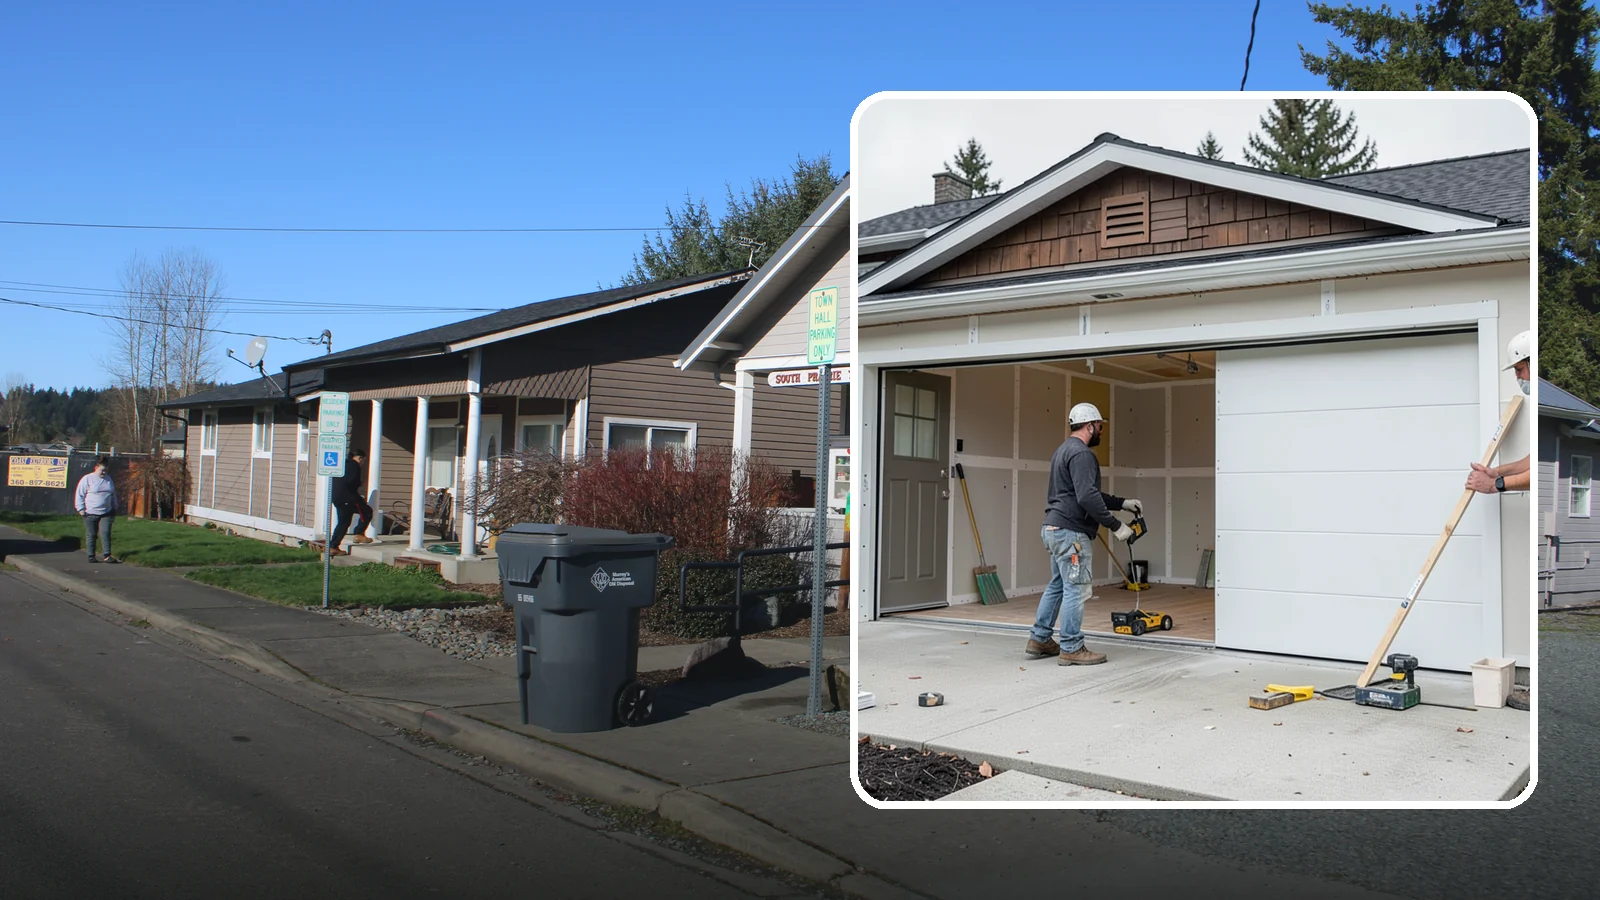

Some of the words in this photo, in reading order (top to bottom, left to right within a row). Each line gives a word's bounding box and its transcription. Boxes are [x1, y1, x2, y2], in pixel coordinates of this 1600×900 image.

[815, 295, 832, 308] TOWN
[814, 312, 831, 324] HALL
[810, 326, 836, 340] PARKING
[814, 344, 830, 357] ONLY
[776, 374, 800, 384] SOUTH
